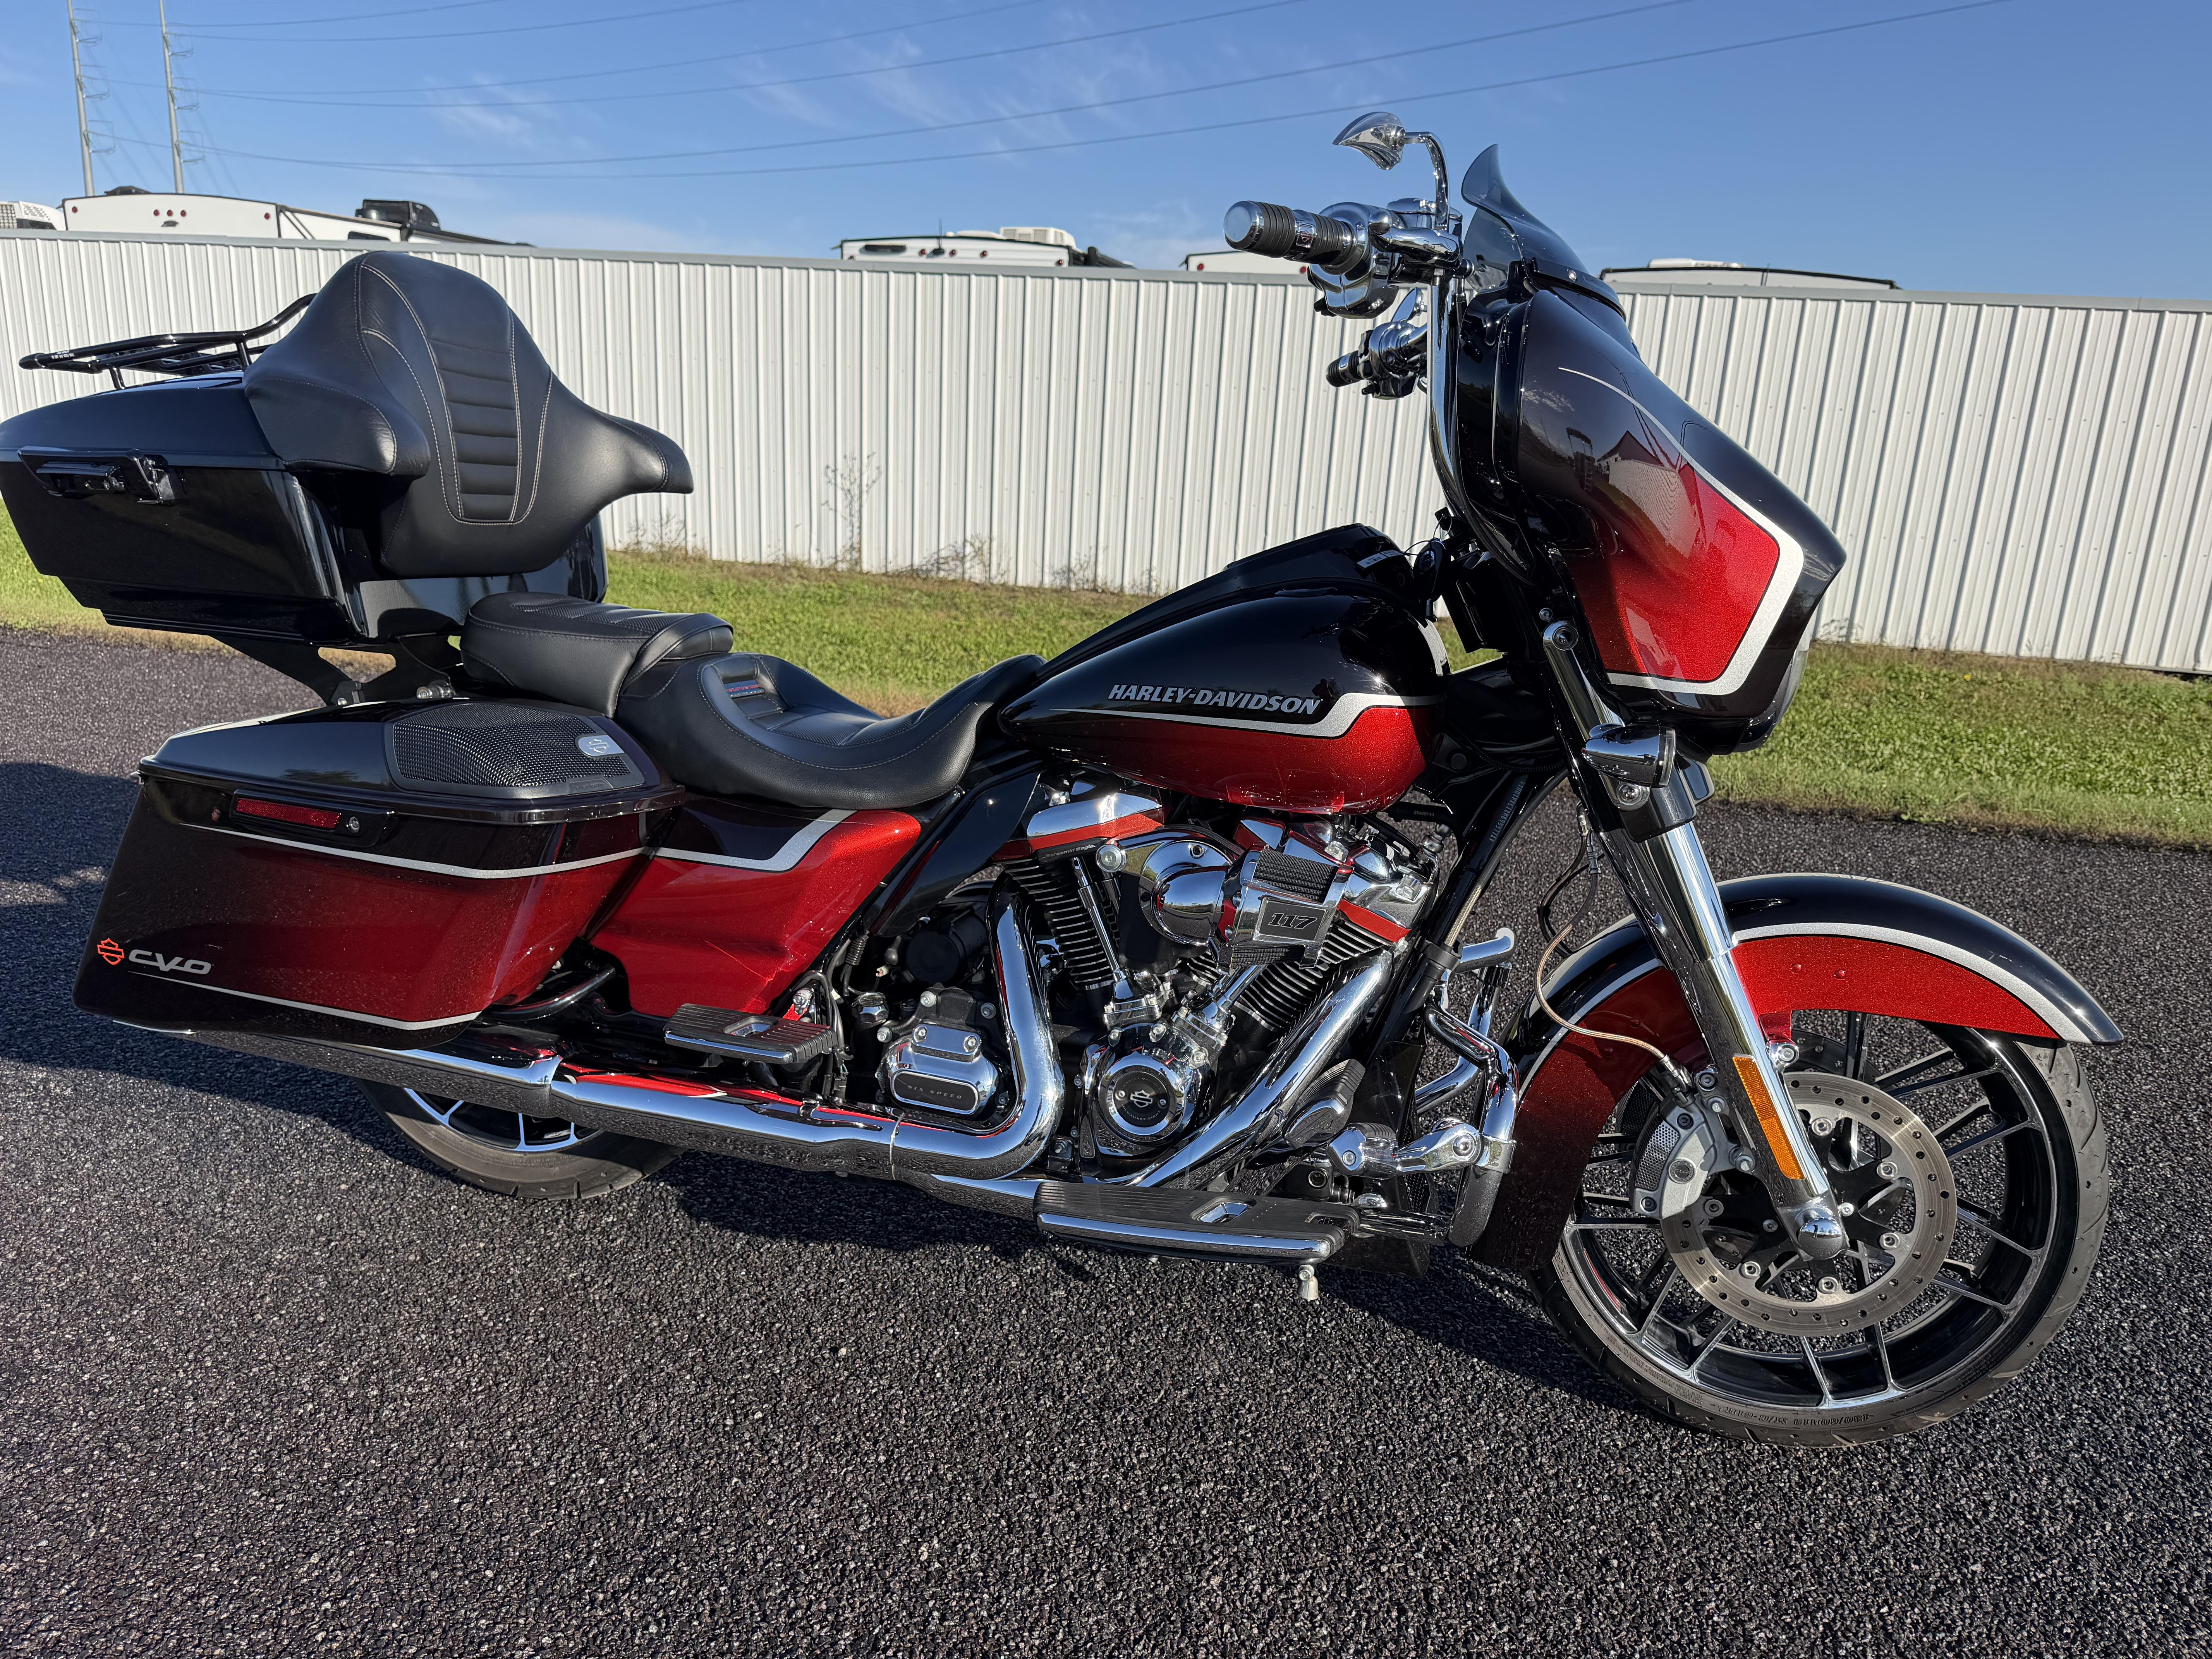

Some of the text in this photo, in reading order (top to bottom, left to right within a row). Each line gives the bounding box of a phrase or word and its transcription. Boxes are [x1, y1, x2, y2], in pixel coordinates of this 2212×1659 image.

[1108, 684, 1321, 715] HARLEY-DAVIDSON
[1268, 913, 1318, 929] 117
[129, 949, 211, 975] CVO
[930, 1090, 962, 1099] SPEED
